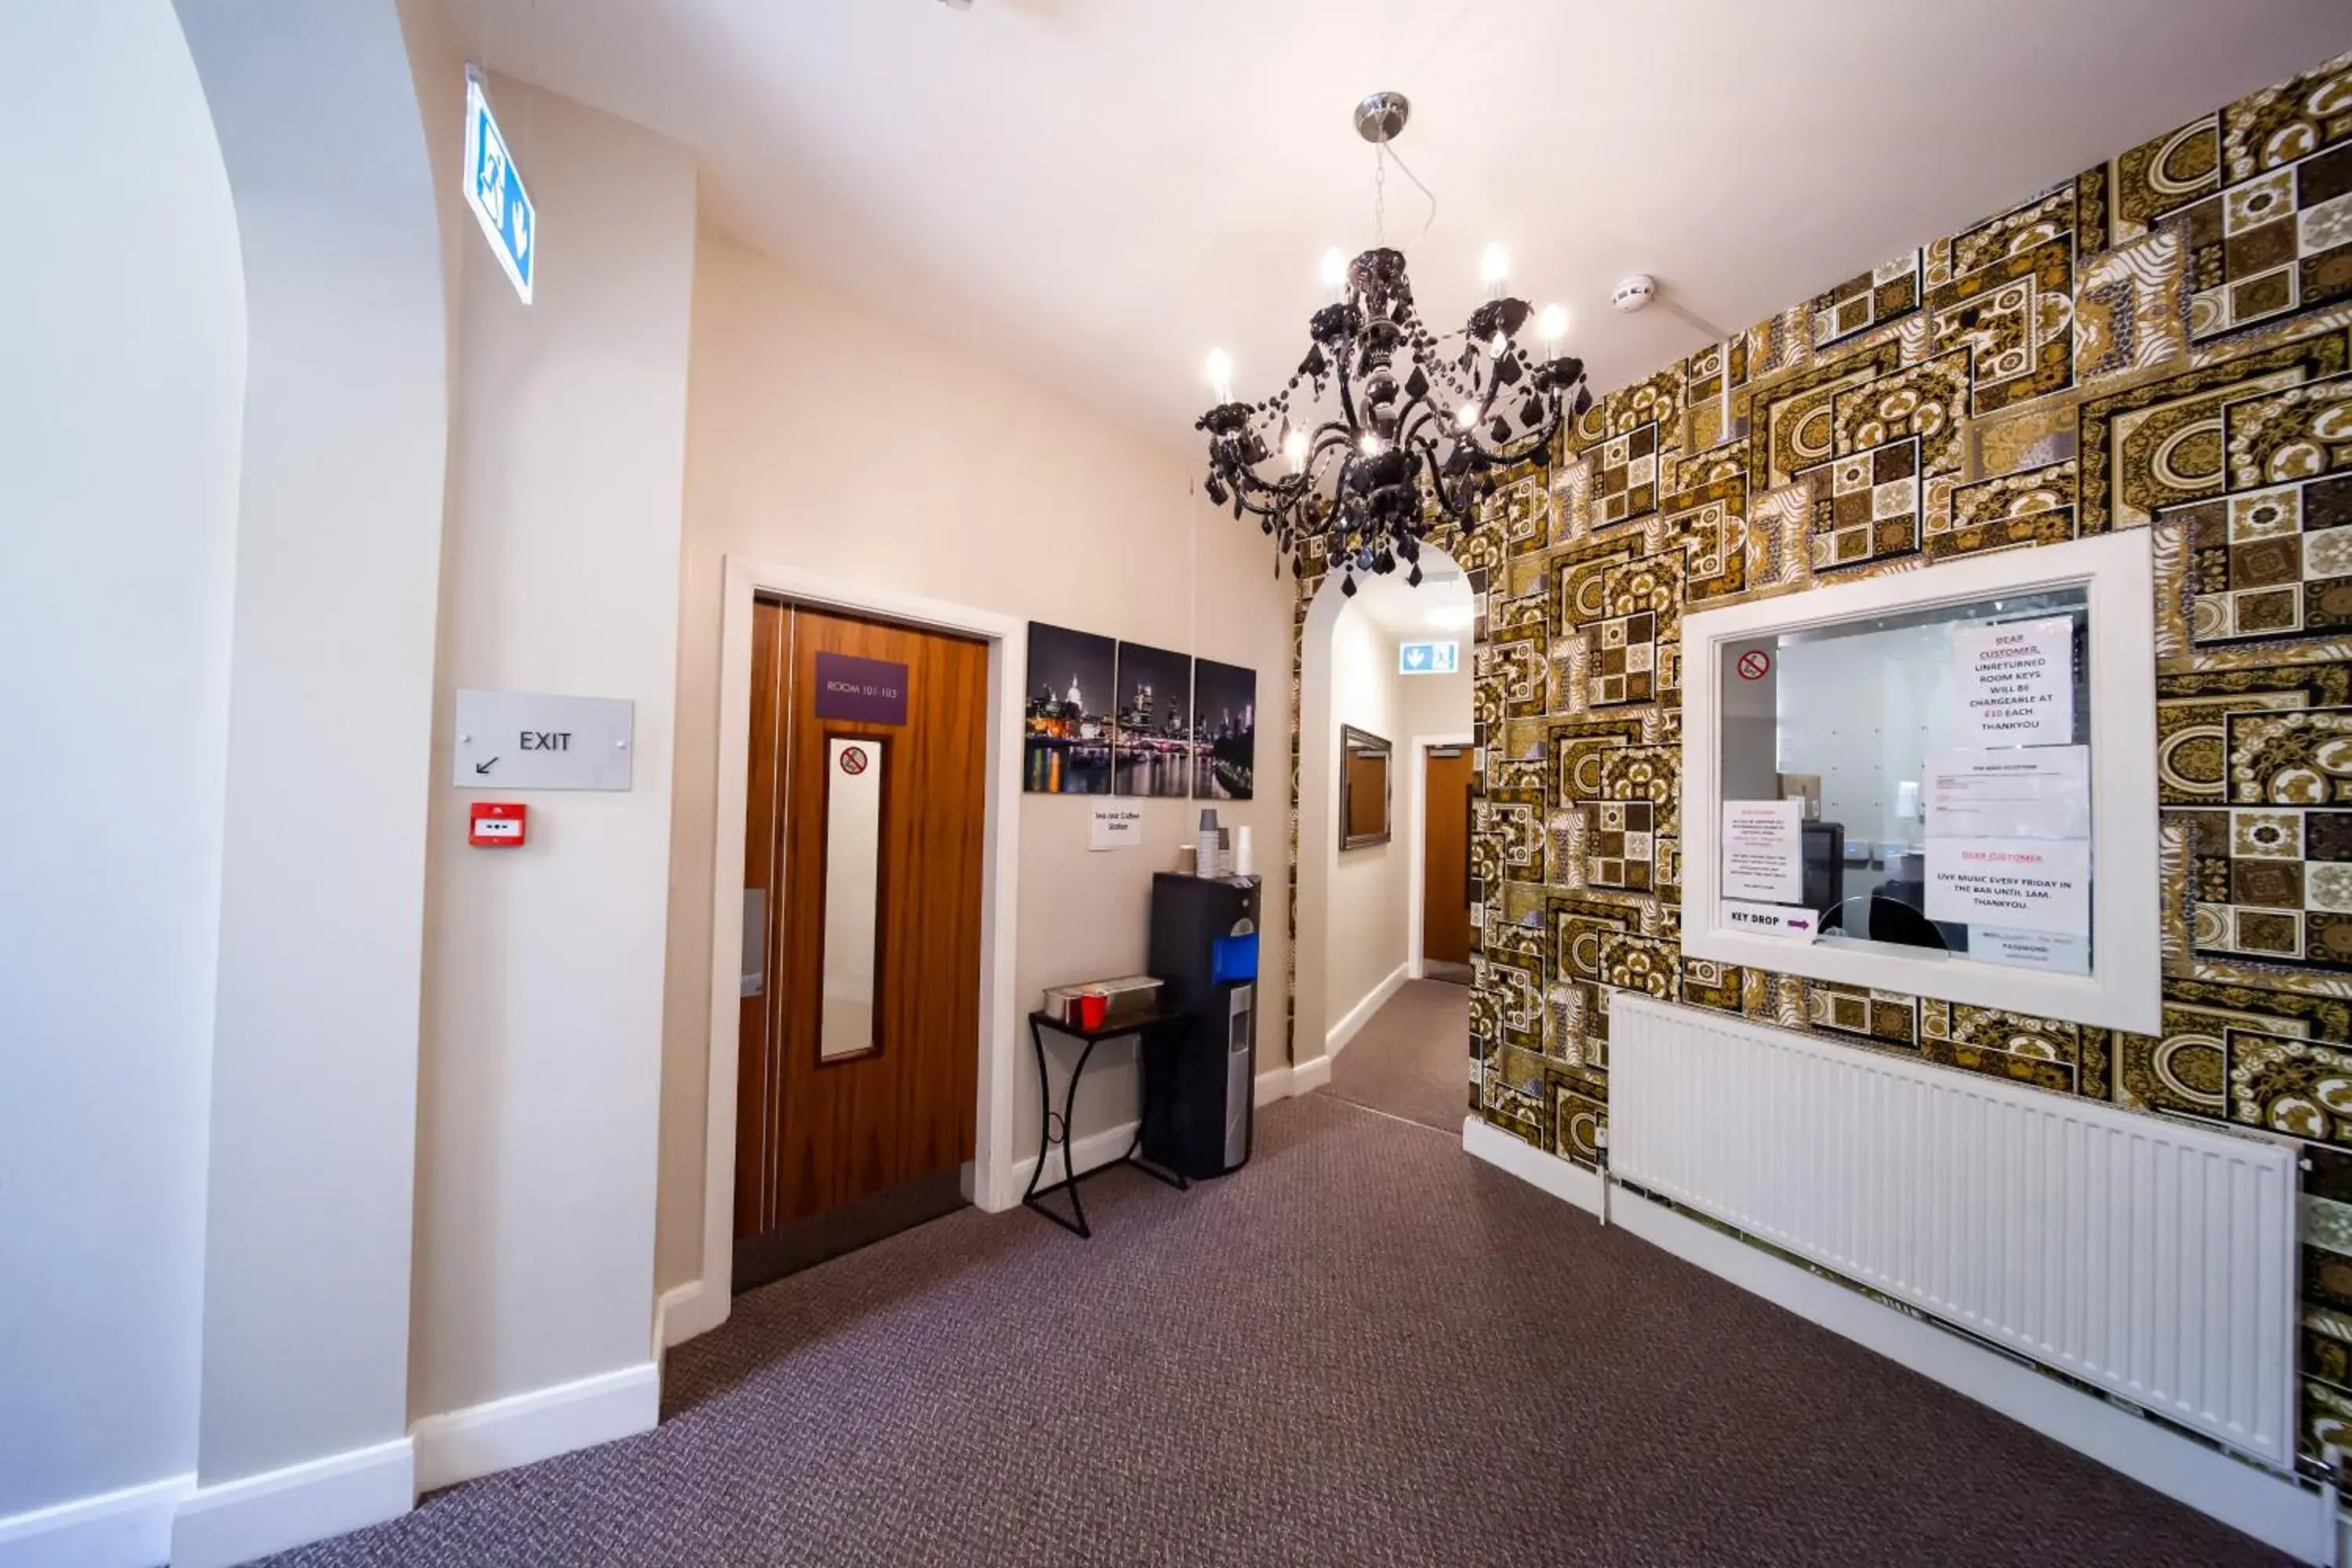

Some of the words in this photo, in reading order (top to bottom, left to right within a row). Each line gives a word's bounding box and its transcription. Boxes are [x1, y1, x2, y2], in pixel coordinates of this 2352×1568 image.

[1996, 634, 2024, 644] DEAR
[1976, 659, 2045, 671] UNRETURNED
[1980, 674, 2013, 683] ROOM
[827, 680, 860, 694] ROOM
[862, 684, 897, 699] 101-103
[1969, 696, 2036, 707] CHARGEABLE
[2005, 708, 2033, 717] EACH
[1982, 720, 2039, 730] THANKYOU
[520, 731, 571, 750] EXIT
[1962, 851, 1987, 860] DEAR
[2022, 879, 2056, 887] FRIDAY
[1994, 887, 2021, 896] UNTIL
[1731, 912, 1749, 922] KEY
[1751, 914, 1780, 925] DROP
